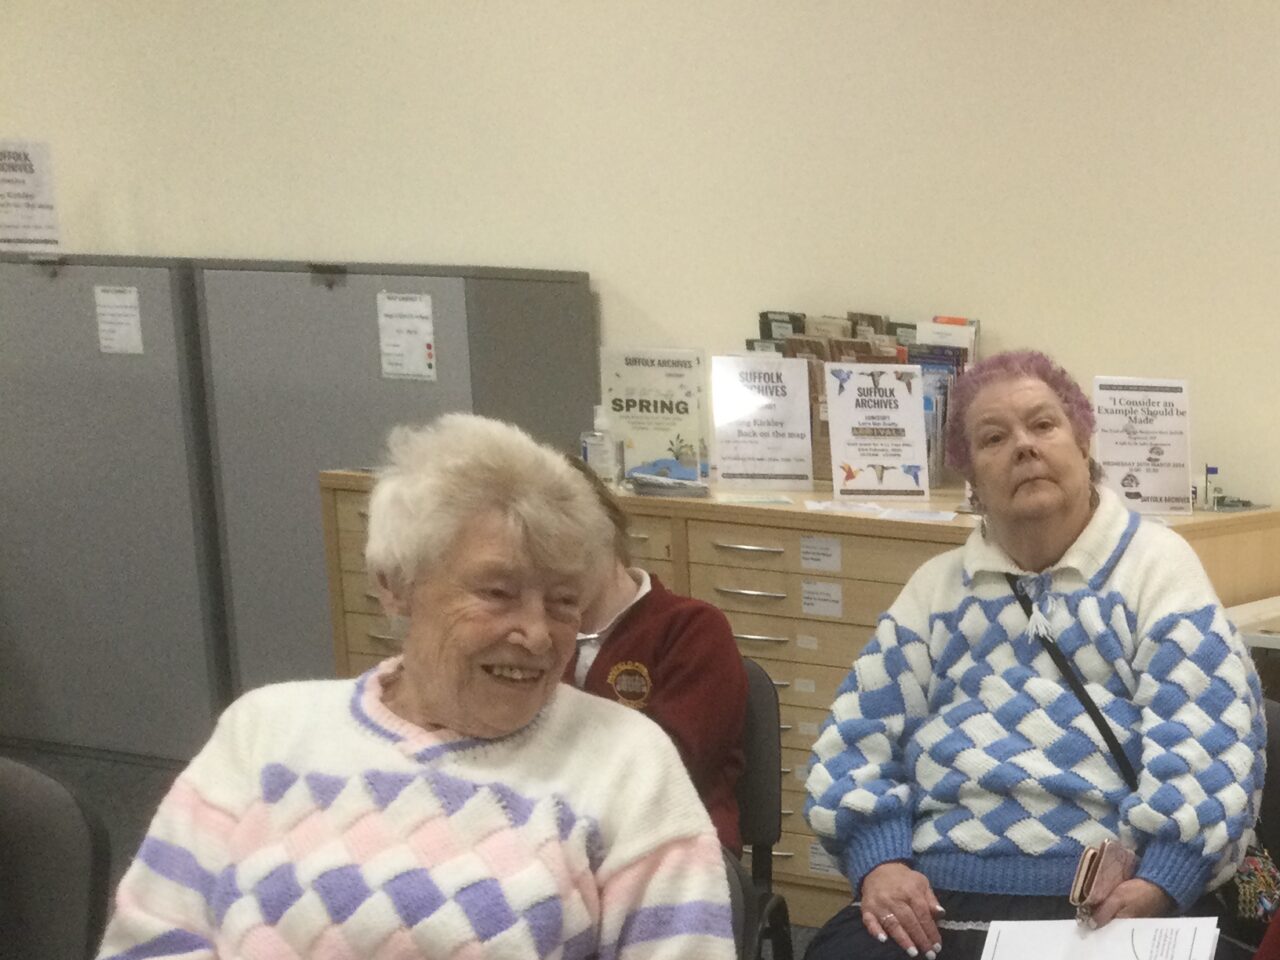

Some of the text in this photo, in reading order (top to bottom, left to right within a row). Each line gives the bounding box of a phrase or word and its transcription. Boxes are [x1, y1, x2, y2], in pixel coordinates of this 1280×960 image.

[857, 387, 895, 398] SUFFOLK
[611, 398, 689, 414] SPRING
[855, 399, 899, 409] ARCHIVES
[1118, 397, 1160, 408] Consider
[1162, 400, 1174, 408] an
[1097, 405, 1187, 418] Example Should be
[772, 430, 786, 438] the
